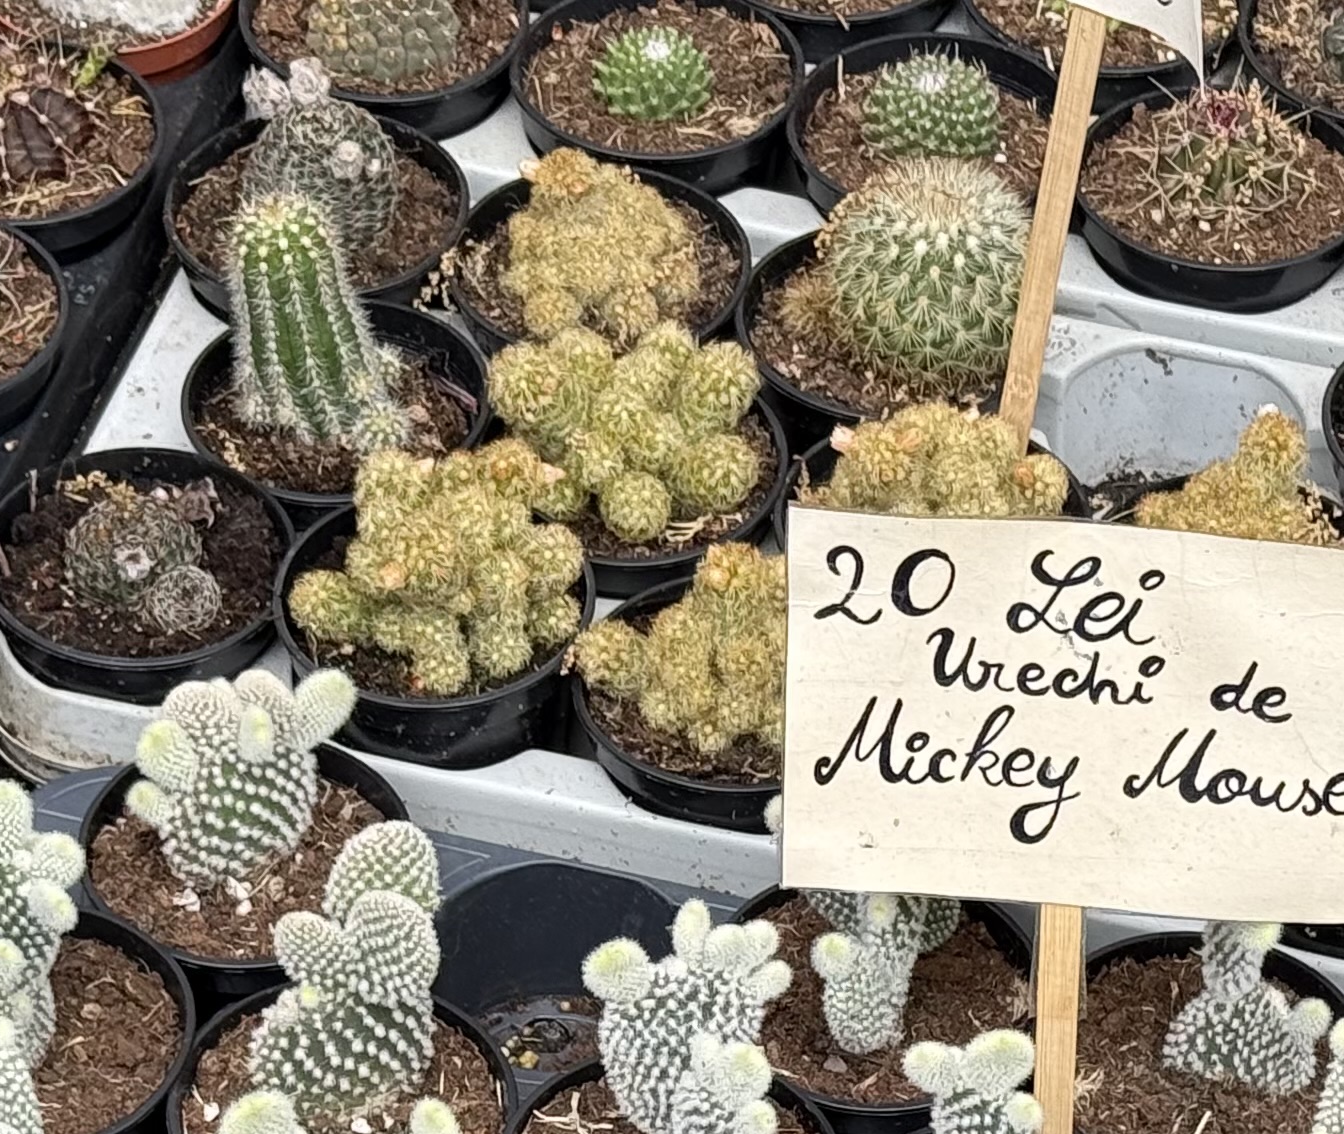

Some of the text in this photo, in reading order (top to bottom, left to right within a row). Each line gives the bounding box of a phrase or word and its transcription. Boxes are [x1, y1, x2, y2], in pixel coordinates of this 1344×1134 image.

[813, 545, 1166, 646] 20 Lei
[926, 627, 1293, 724] Urechi de
[813, 696, 1081, 845] Mickey
